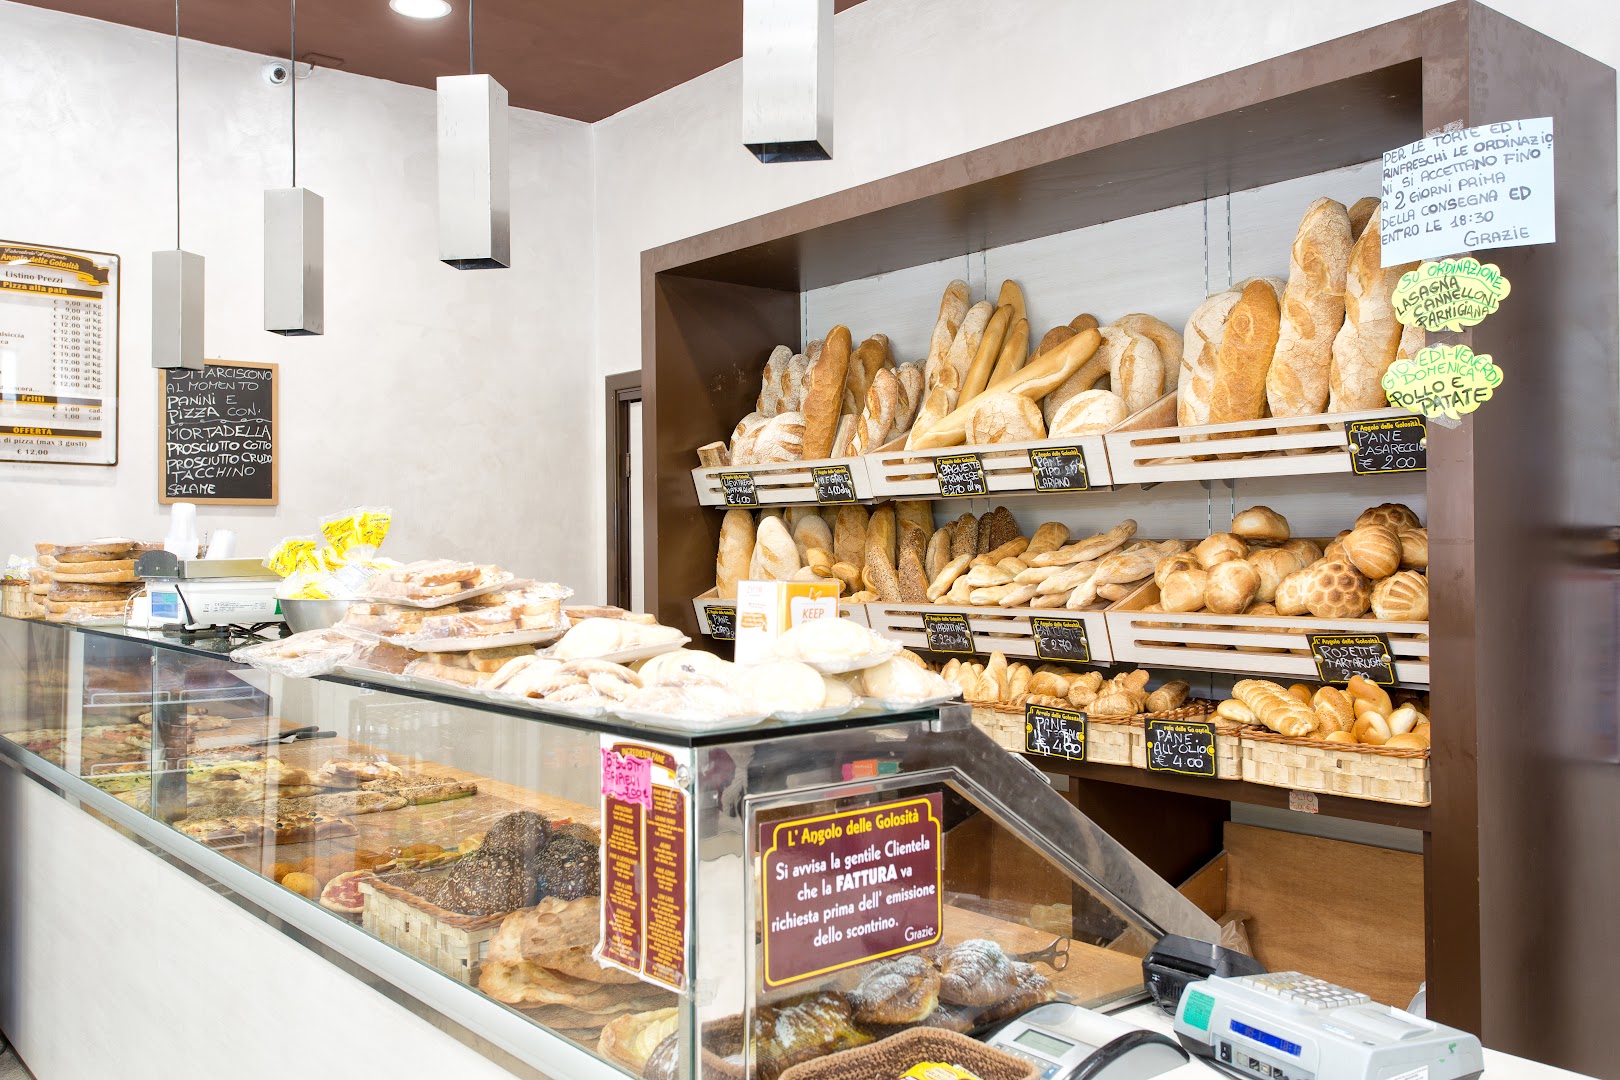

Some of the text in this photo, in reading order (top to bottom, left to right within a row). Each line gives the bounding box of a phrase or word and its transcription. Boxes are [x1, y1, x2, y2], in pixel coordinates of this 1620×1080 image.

[1384, 122, 1512, 167] PER LE TORTE ED
[1453, 145, 1469, 158] LE
[1421, 155, 1497, 182] ACCETTANO
[1504, 149, 1541, 165] FINO
[1382, 171, 1506, 212] A 2 GIORNI PRIMA
[1382, 186, 1531, 231] DELLA CONSEGNA ED
[1382, 211, 1494, 246] ENTRO LE 18:30
[30, 255, 48, 264] delle
[49, 258, 79, 270] Golosità
[5, 271, 63, 283] Listino Prezzi
[1402, 260, 1503, 291] SU ORDINAZIONE
[3, 281, 68, 295] Pizza alla pala
[1396, 275, 1460, 316] LASAGNA
[1413, 287, 1497, 318] CANNELLONI
[1416, 302, 1490, 328] PARMIGIANA
[1404, 361, 1475, 386] DOMENICA
[167, 381, 259, 394] AL MOMENTO
[1390, 376, 1464, 407] POLLO E
[21, 394, 45, 402] Fritti
[167, 393, 237, 409] PANINI E
[1416, 387, 1488, 415] PATATE
[167, 407, 220, 424] PIZZA
[13, 427, 52, 435] OFFERTA
[167, 425, 272, 440] MORTADELLA
[1360, 424, 1380, 433] Angolo
[1395, 420, 1419, 429] Golosità
[1353, 430, 1402, 446] PANE
[167, 440, 272, 457] PROSCIUTTO COTTO
[167, 452, 272, 474] PROSCIUTTO CRUDO
[941, 462, 979, 475] BAGUETTE
[1034, 456, 1062, 467] PANE
[1359, 458, 1377, 470] €
[171, 464, 255, 483] TACCHINO
[943, 472, 979, 484] FRANCESE
[1039, 467, 1060, 476] TIPO
[167, 483, 216, 496] SALAME
[1037, 477, 1070, 488] LARIANO
[802, 608, 825, 619] KEEP
[1319, 645, 1379, 659] ROSETTE
[1036, 716, 1067, 731] PANE
[1156, 730, 1192, 745] PANE
[652, 751, 665, 764] PANE
[1155, 755, 1168, 766] €
[788, 808, 919, 847] L' Angolo delle Golosità
[776, 834, 930, 880] Si avvisa la gentile Clientela
[797, 864, 912, 901] che la FATTURA va
[772, 884, 935, 932] richiesta prima dell' emissione
[814, 917, 898, 947] dello scontrino.
